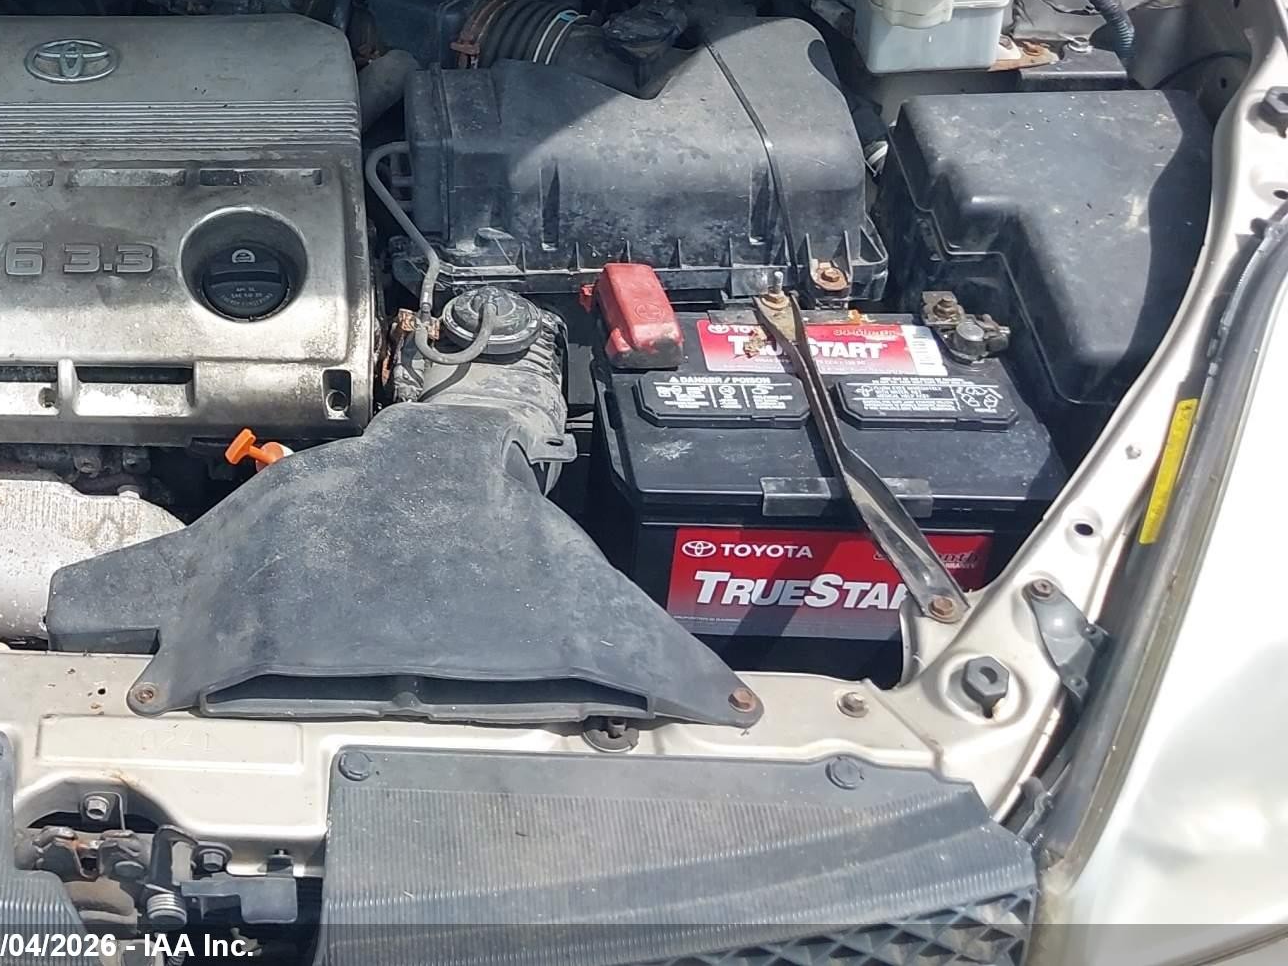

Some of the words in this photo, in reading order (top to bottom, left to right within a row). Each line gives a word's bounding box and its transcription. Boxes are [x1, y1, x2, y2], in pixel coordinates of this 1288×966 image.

[62, 242, 155, 274] 3.3
[679, 376, 722, 384] DANGER
[732, 376, 772, 384] POISON
[720, 543, 814, 559] TOYOTA
